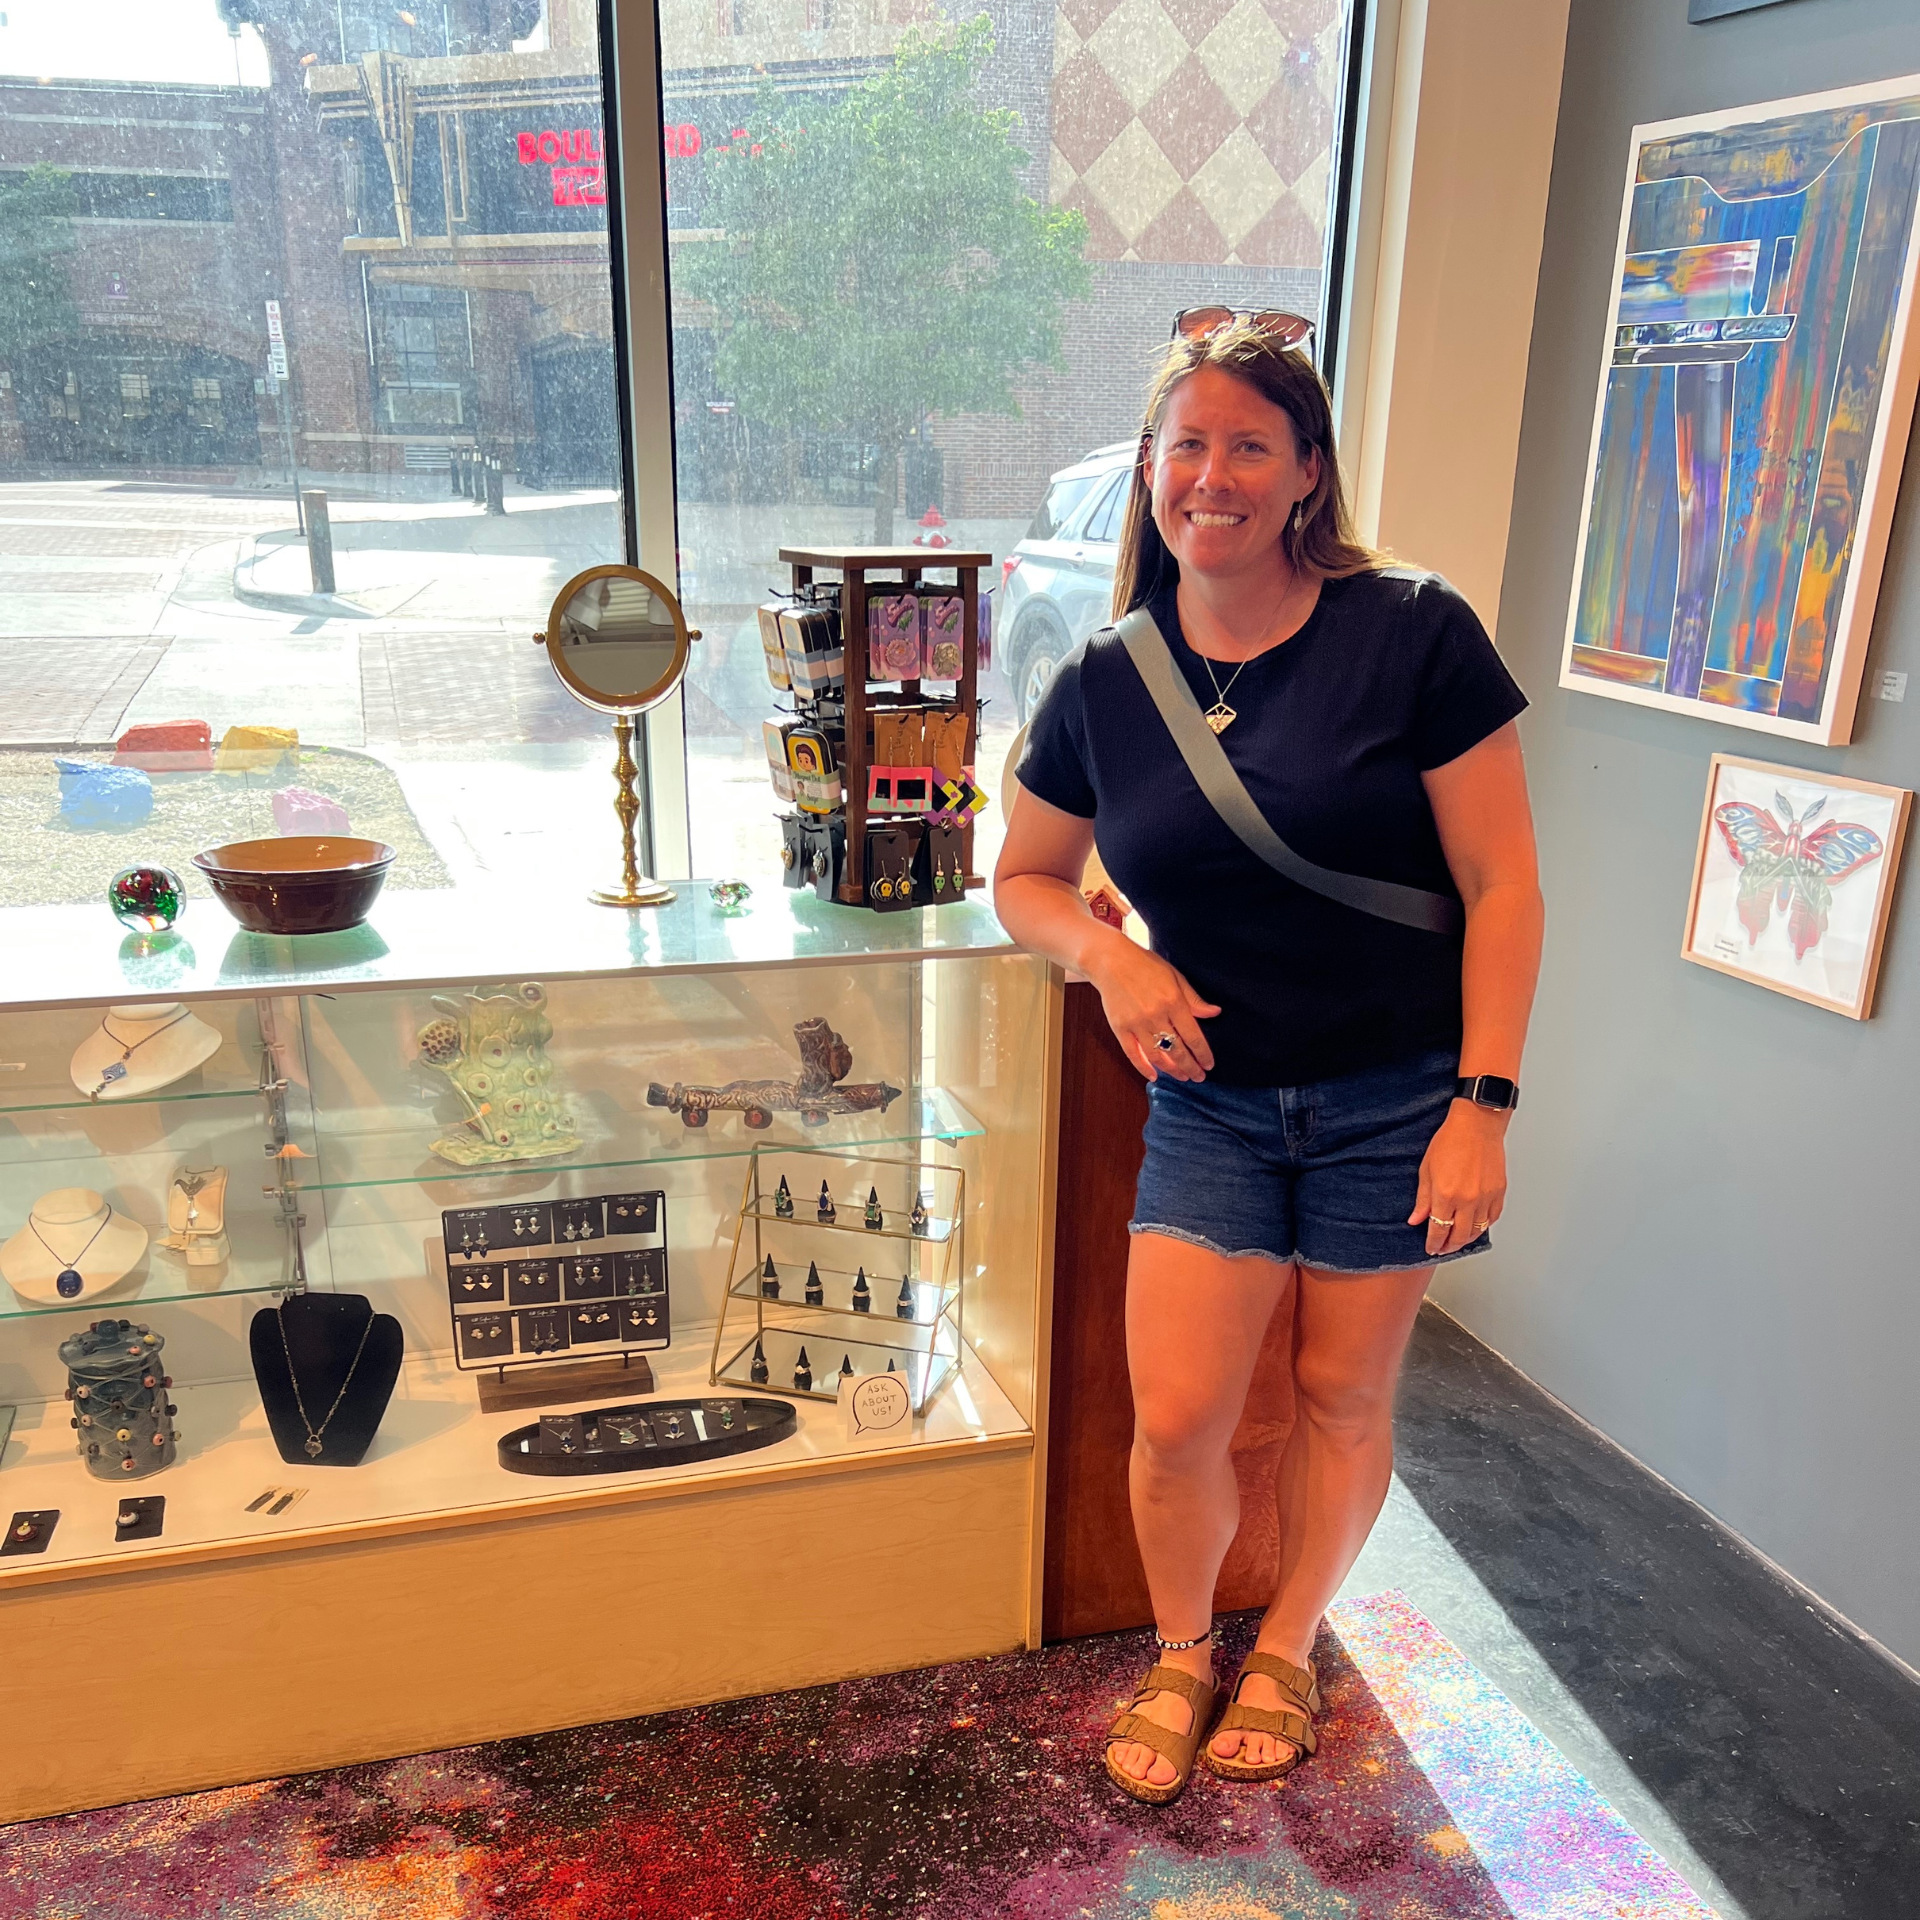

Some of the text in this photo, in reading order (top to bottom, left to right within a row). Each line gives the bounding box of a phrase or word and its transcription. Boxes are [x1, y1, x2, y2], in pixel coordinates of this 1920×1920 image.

[517, 124, 701, 164] BOULRD
[84, 313, 109, 322] FREE
[867, 1383, 889, 1394] ASK
[862, 1394, 897, 1408] ABOUT
[872, 1405, 892, 1416] US!
